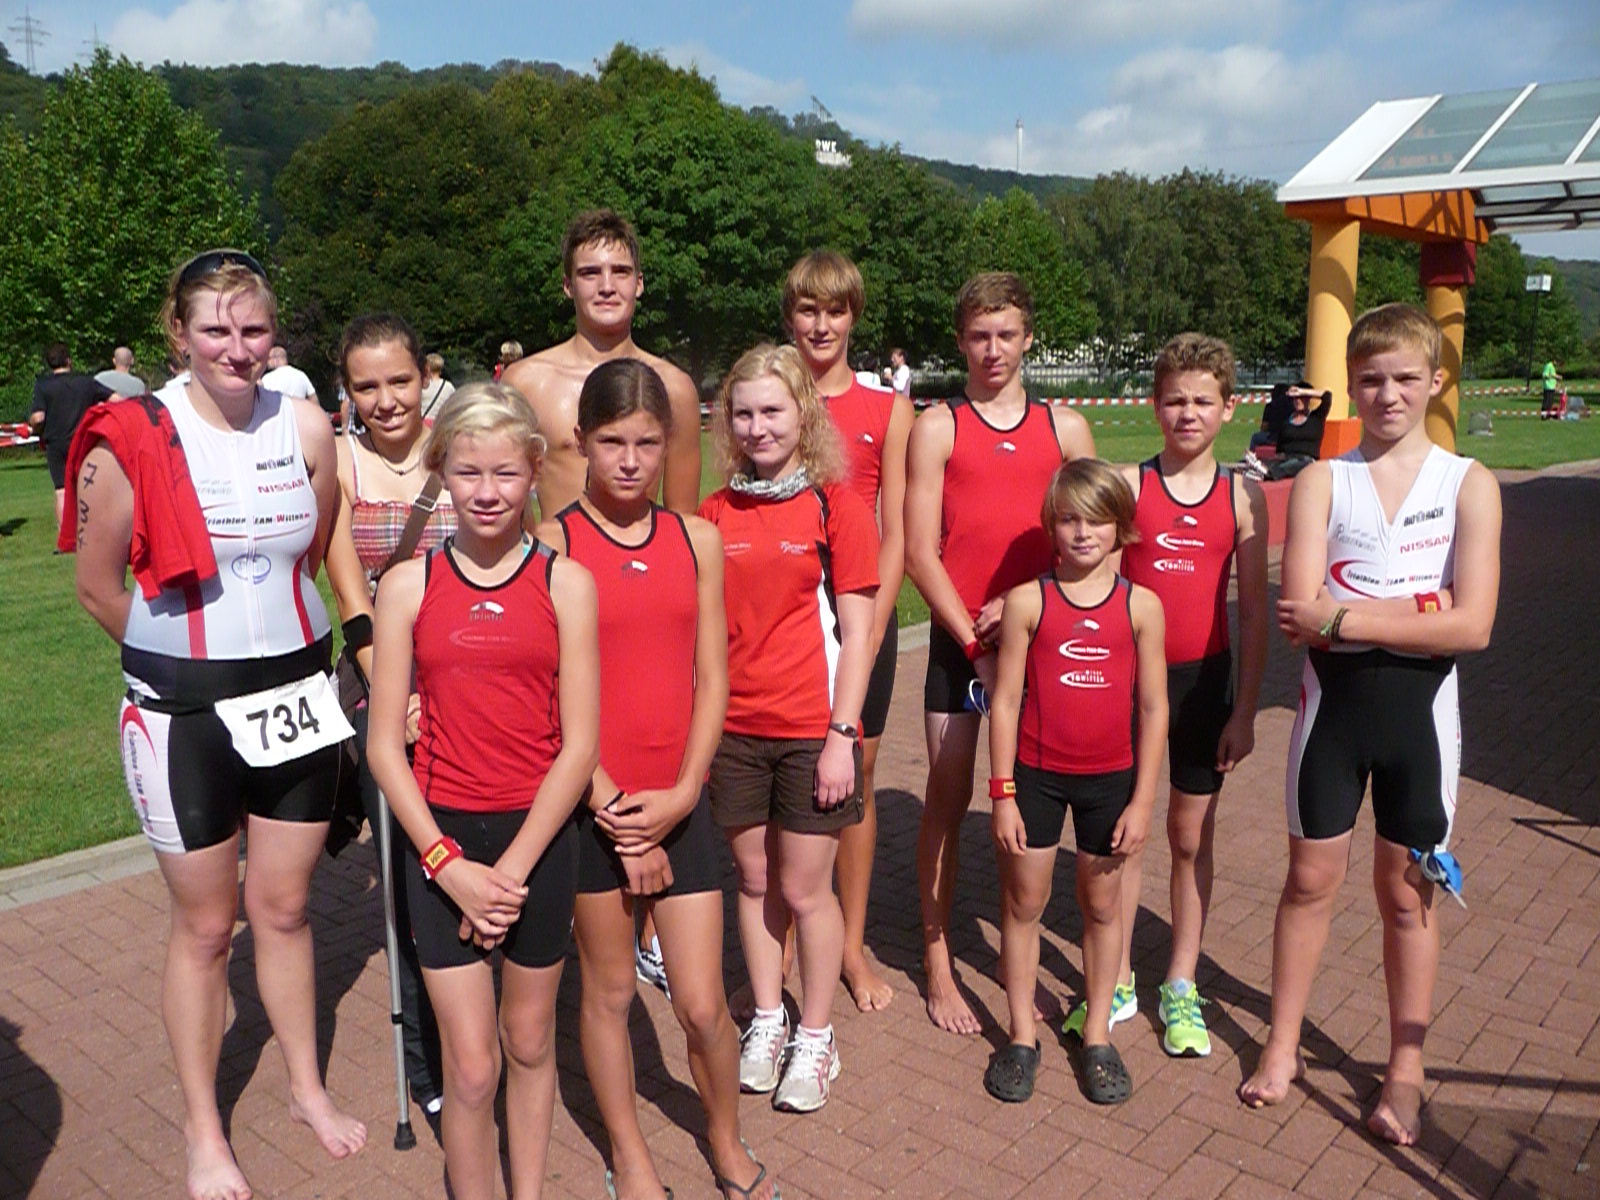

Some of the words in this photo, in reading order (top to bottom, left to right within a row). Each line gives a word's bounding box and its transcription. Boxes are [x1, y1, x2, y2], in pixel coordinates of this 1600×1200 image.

[257, 478, 305, 494] NISSAN
[204, 516, 246, 525] riathlon
[1400, 534, 1451, 554] NISSAN
[246, 696, 320, 751] 734
